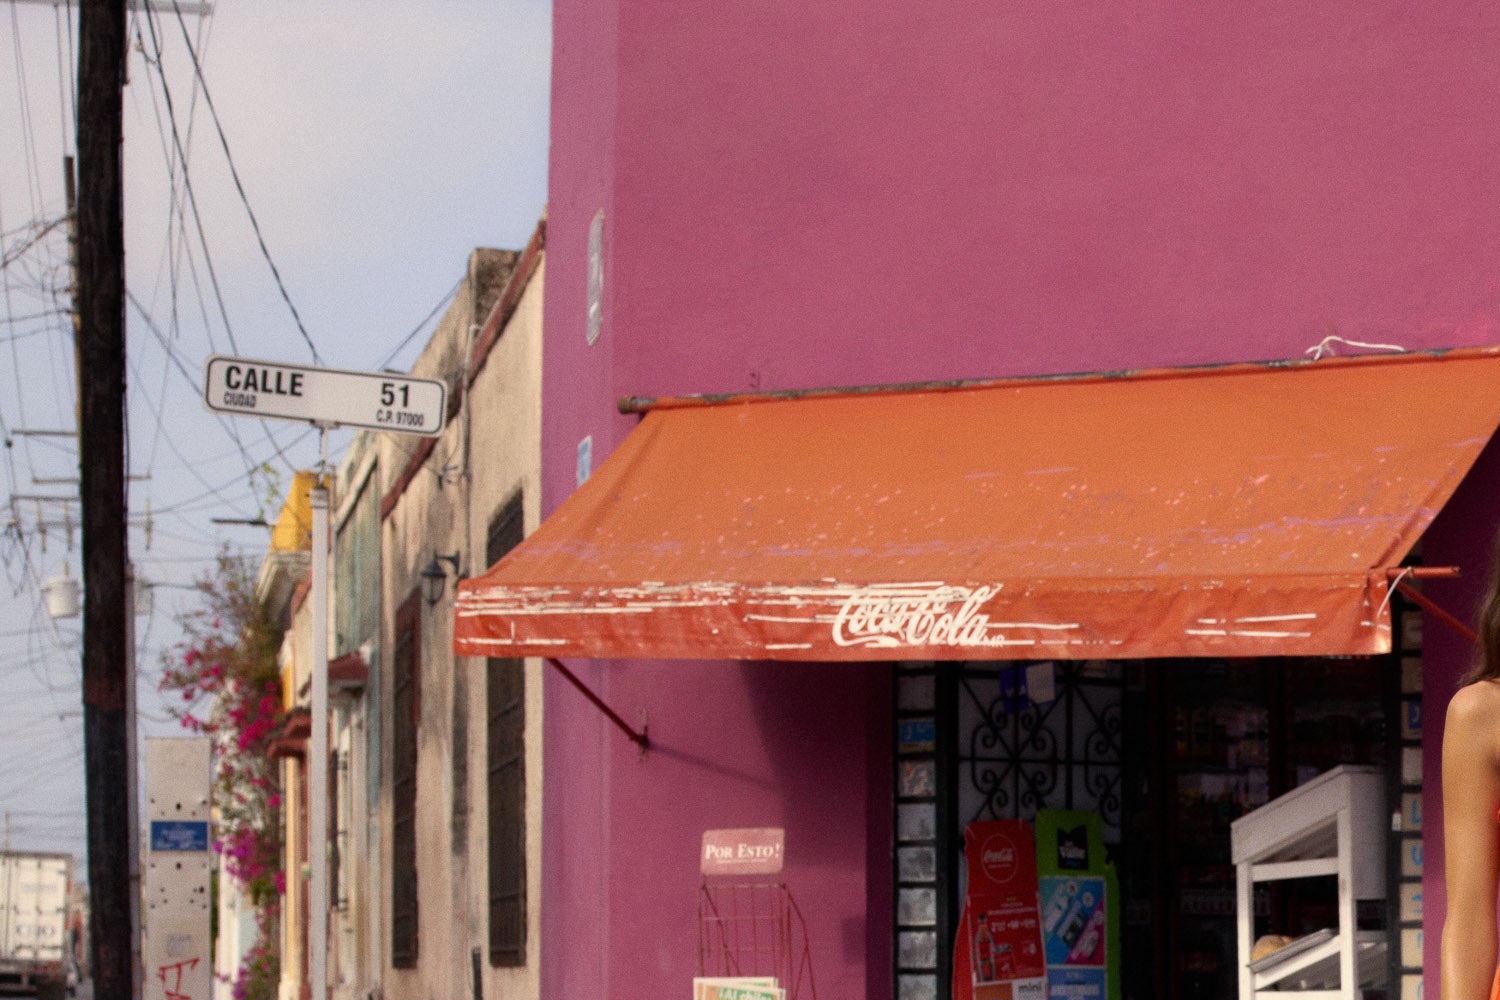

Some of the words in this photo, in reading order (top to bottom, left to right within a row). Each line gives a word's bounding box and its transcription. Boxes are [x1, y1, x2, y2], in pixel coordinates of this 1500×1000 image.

[225, 365, 304, 397] CALLE
[380, 382, 410, 408] 51
[223, 391, 257, 408] CIUDAD
[396, 411, 425, 427] 97000
[832, 583, 1003, 648] Coca-Cola
[1018, 981, 1042, 993] mini
